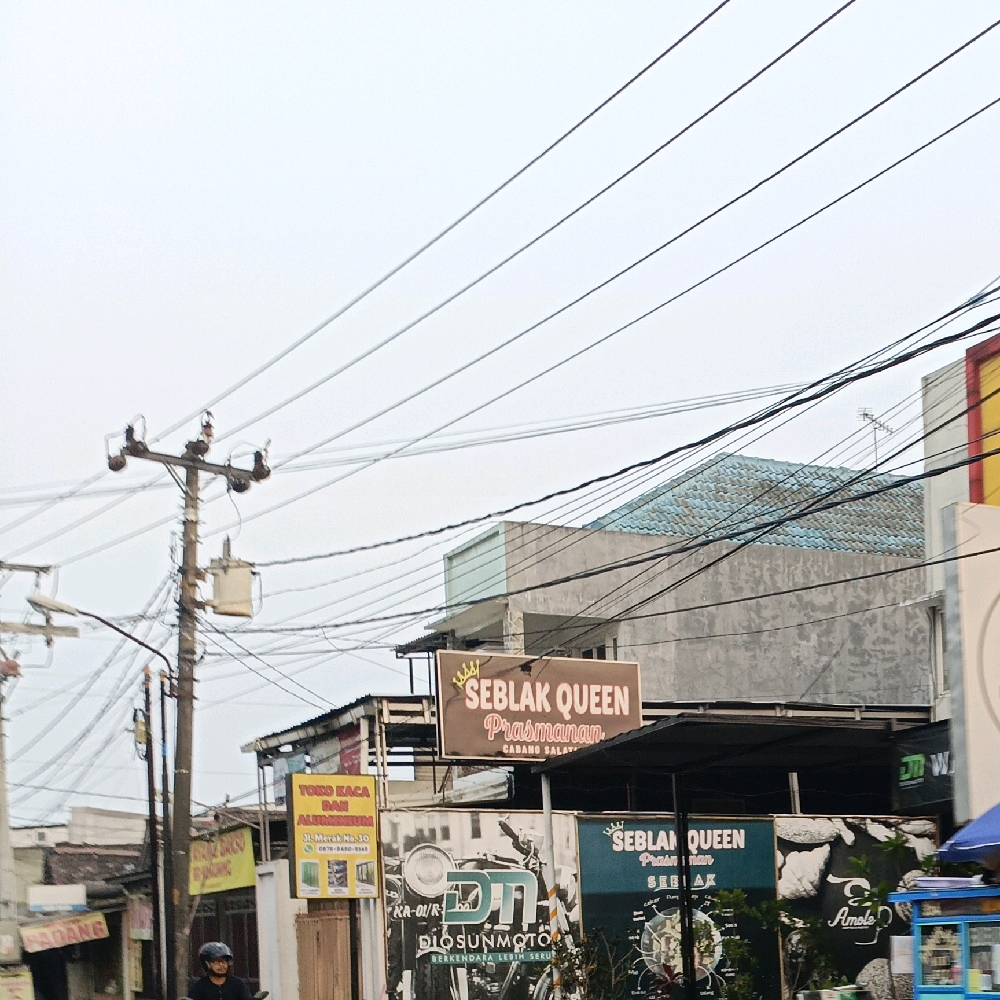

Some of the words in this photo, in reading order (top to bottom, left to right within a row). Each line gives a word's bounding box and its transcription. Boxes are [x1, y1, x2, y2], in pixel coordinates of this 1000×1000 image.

[465, 678, 551, 713] SEBLAK
[556, 682, 630, 721] QUEEN
[483, 713, 605, 744] Prasmanan
[299, 784, 335, 797] TOKO
[336, 785, 371, 798] KACA
[322, 800, 349, 812] DAN
[297, 814, 375, 827] ALUMINIUM
[315, 833, 341, 842] Merak
[688, 829, 746, 854] QUEEN
[639, 852, 714, 867] Prasmnan
[418, 933, 551, 950] DIOSUNMOTO
[431, 954, 493, 963] BERKENDARA
[498, 953, 525, 962] LEBIH
